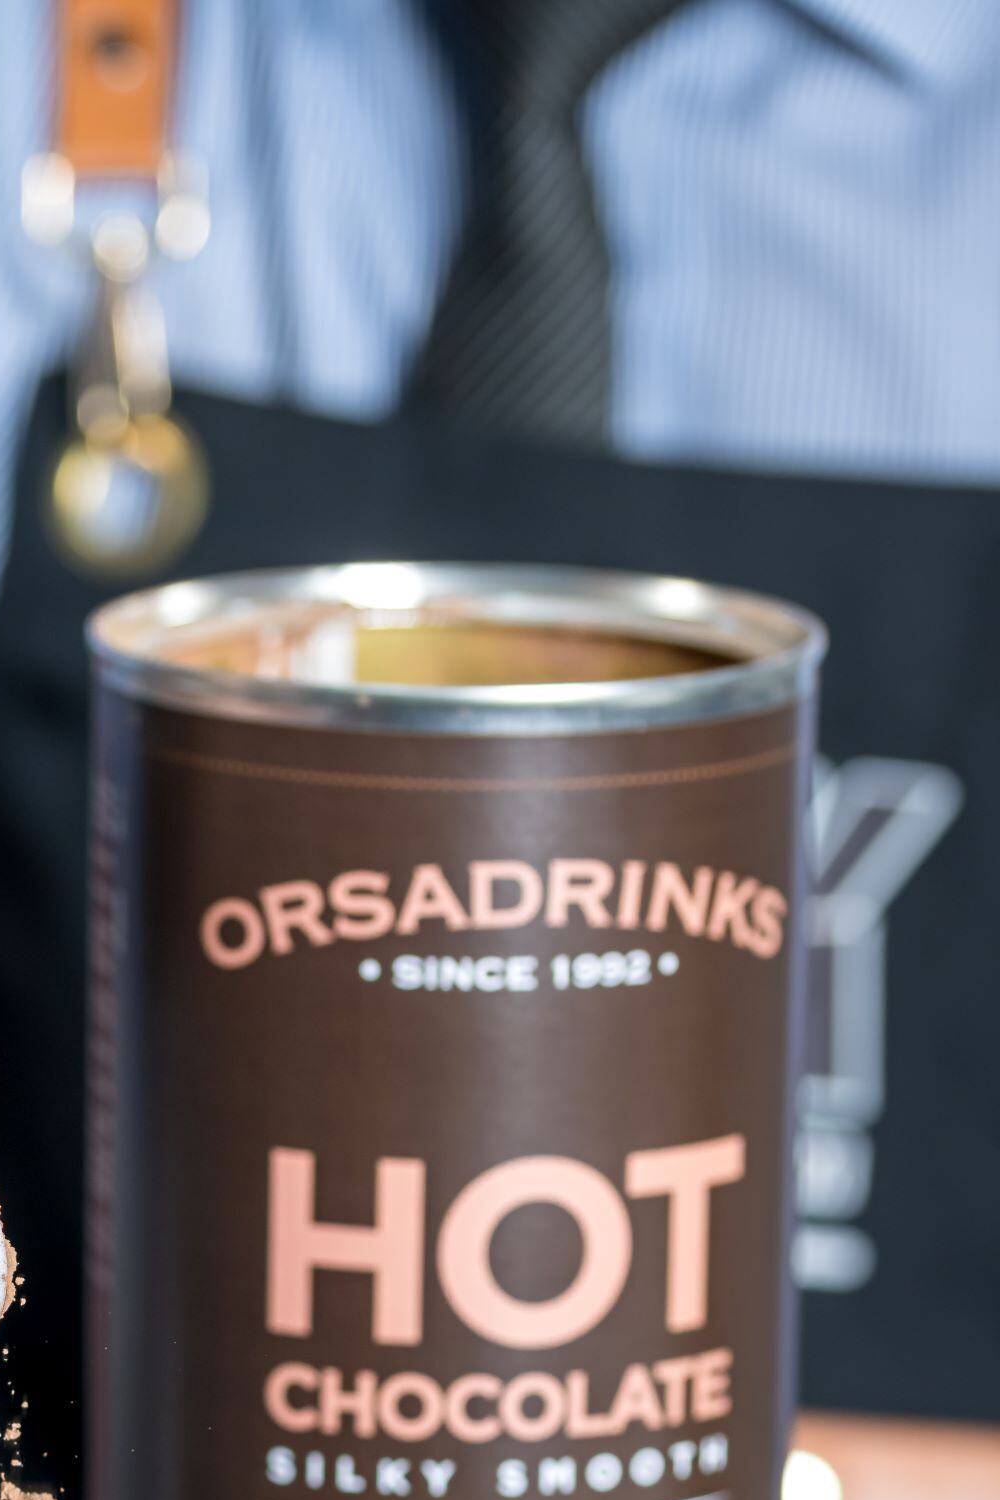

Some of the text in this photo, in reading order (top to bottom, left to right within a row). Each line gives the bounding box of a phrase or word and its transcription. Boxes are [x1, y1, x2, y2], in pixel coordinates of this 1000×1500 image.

[200, 858, 788, 970] ORSADRINKS
[391, 950, 653, 992] SINCE 1992
[267, 1136, 747, 1351] HOT
[264, 1347, 733, 1443] CHOCOLATE
[265, 1433, 729, 1498] SILKY SMOOTH
